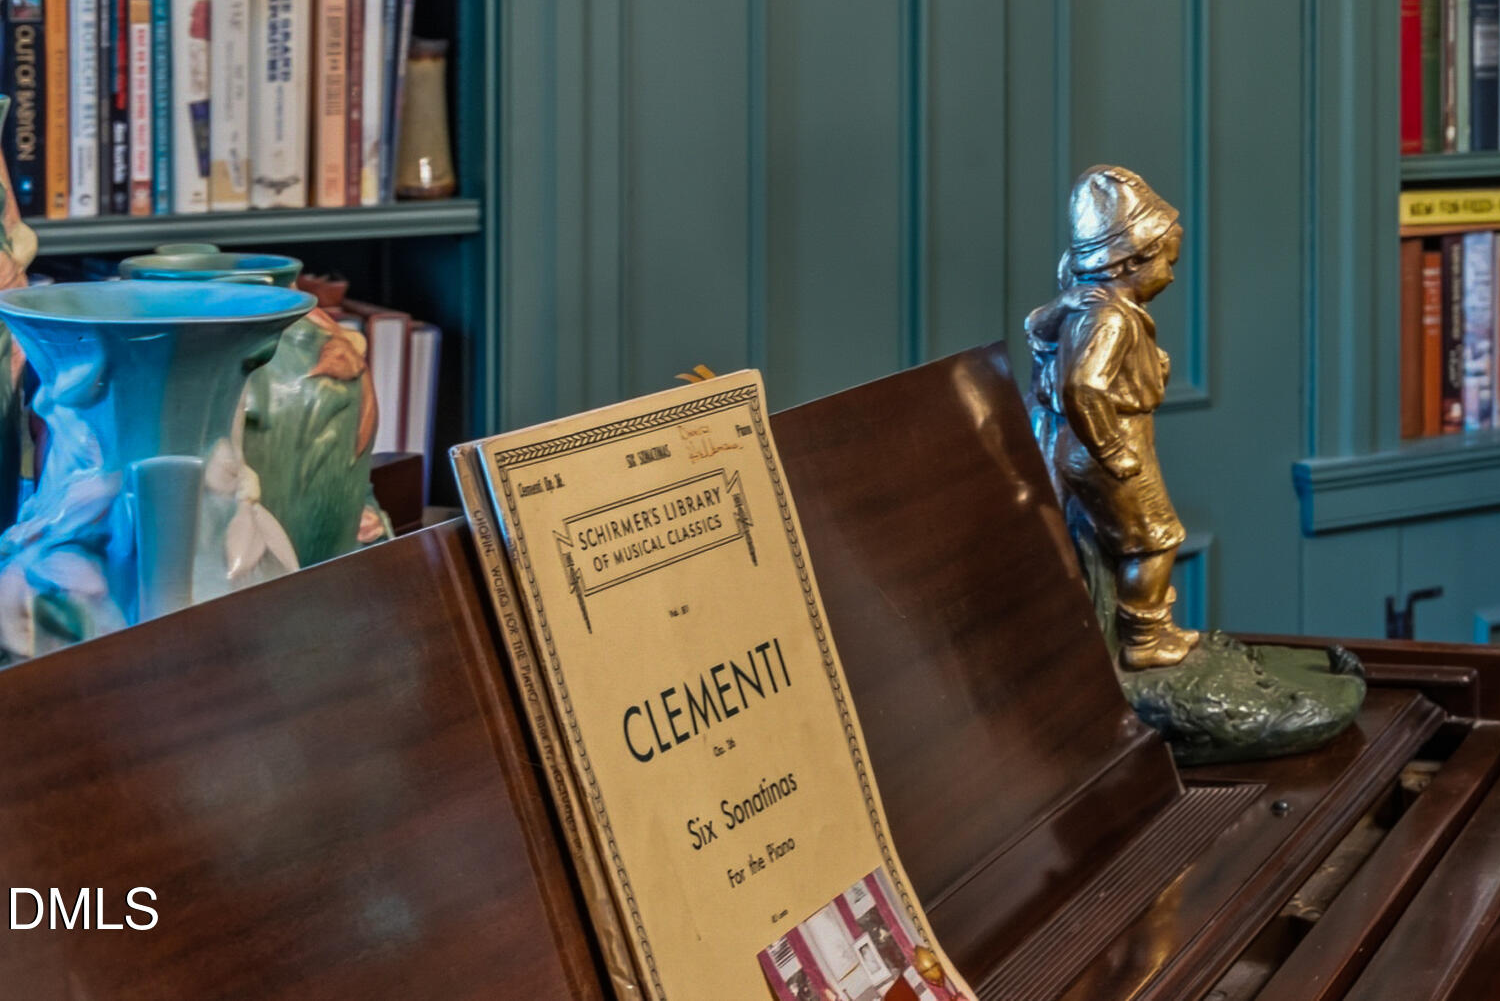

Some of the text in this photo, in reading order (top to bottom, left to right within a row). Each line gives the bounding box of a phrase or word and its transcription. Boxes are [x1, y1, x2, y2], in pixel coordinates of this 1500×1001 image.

[15, 25, 36, 161] OUT OF BABYLON
[578, 487, 721, 551] SCHIRMER'S LIBRARY
[593, 514, 722, 572] OF MUSICAL CLASSICS
[490, 566, 509, 608] WORKS
[504, 612, 518, 635] FOR
[513, 640, 527, 660] THE
[623, 638, 791, 763] CLEMENTI
[687, 773, 798, 850] Six Sonatinas
[727, 838, 795, 888] For the Piano
